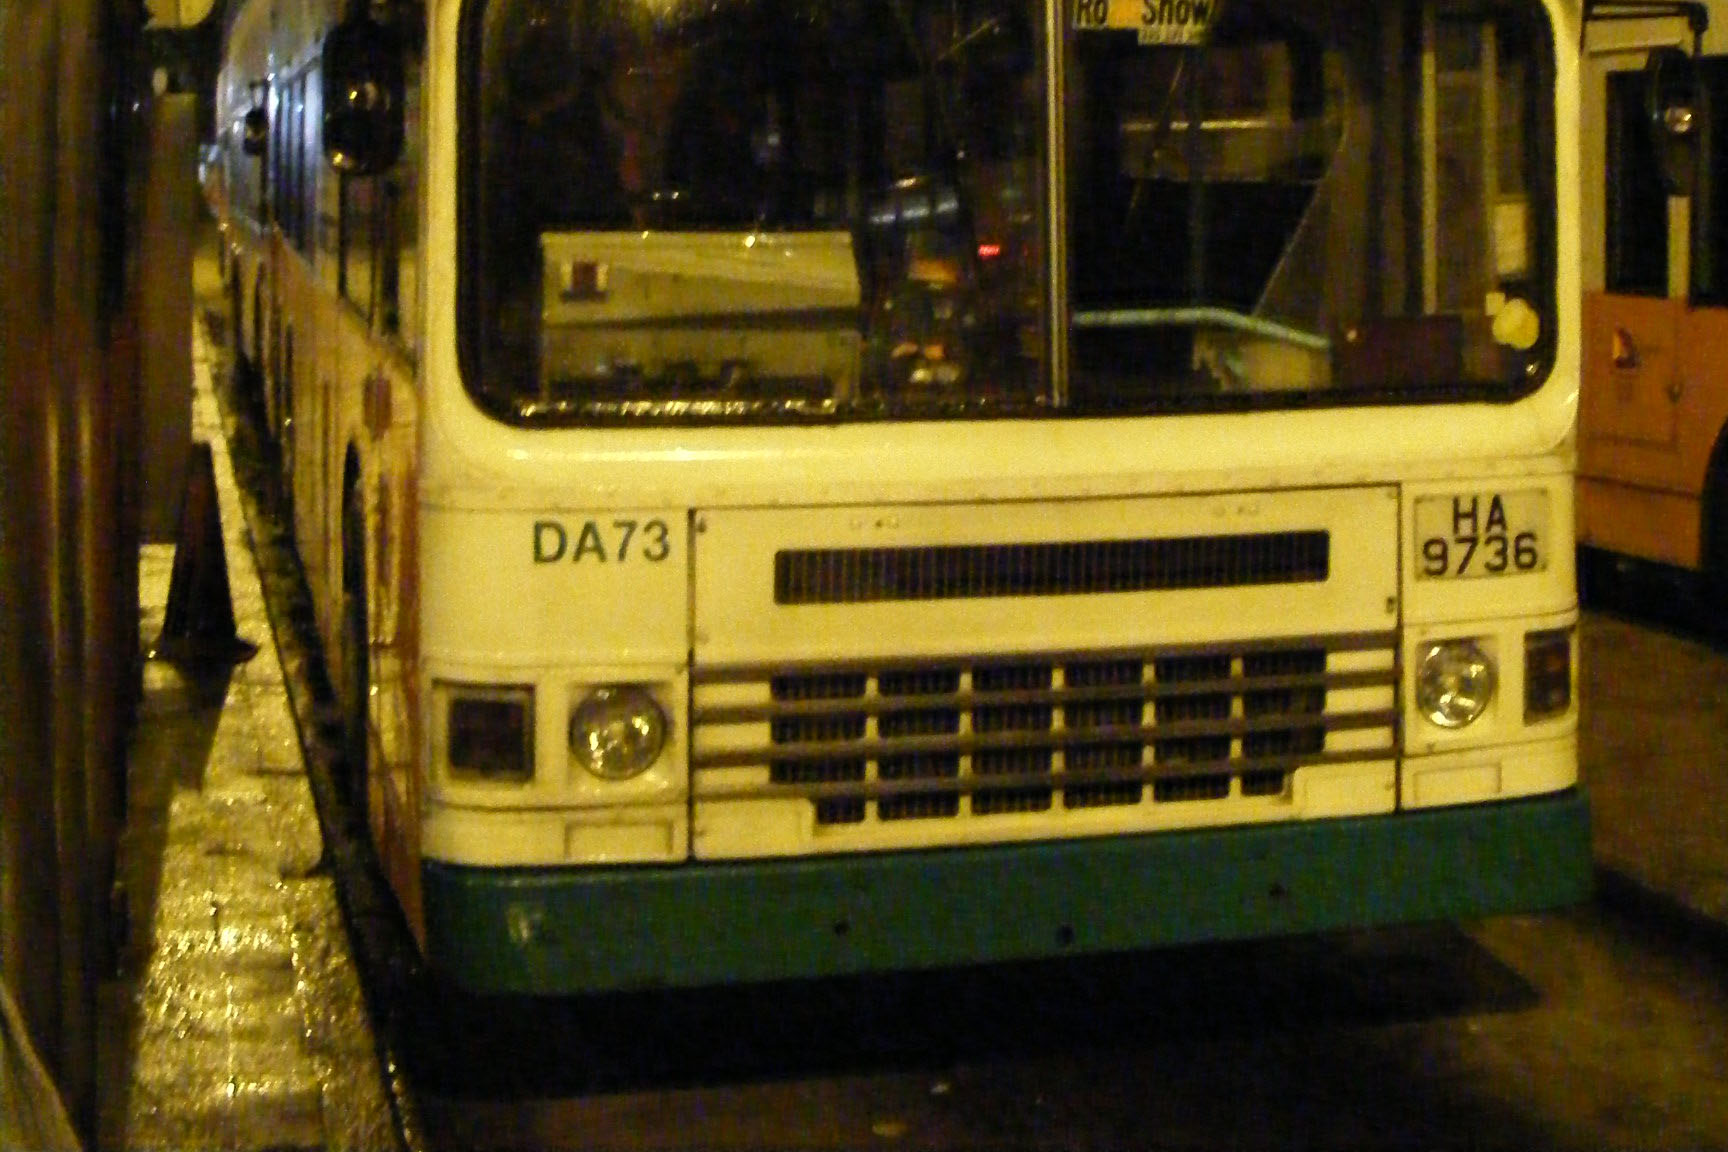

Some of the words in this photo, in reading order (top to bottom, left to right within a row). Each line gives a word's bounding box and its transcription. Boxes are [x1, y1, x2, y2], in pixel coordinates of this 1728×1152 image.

[1453, 494, 1508, 535] HA
[534, 519, 671, 563] DA73
[1422, 531, 1538, 576] 9736
